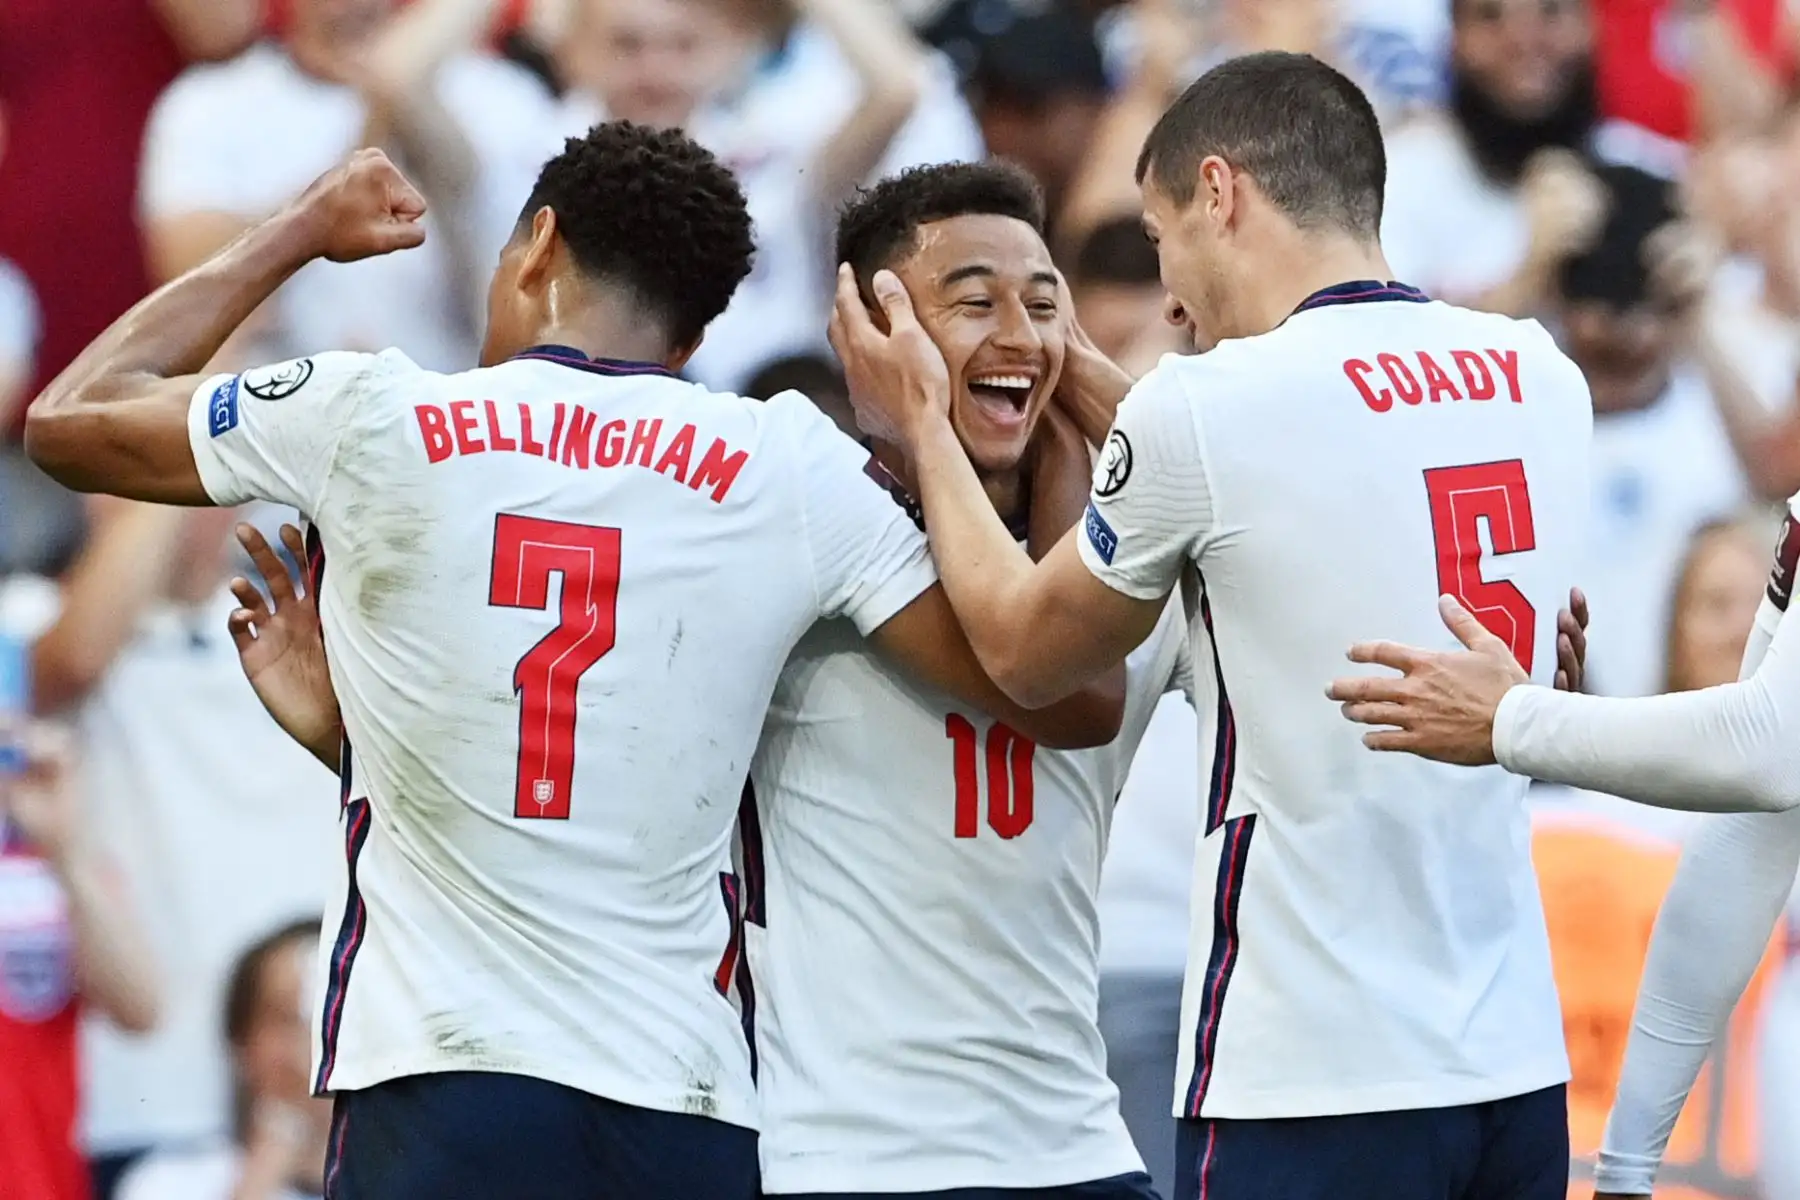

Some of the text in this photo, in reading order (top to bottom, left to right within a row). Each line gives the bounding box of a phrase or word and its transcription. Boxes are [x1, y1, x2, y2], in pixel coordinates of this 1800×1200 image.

[1343, 349, 1523, 413] COADY
[414, 400, 749, 503] BELLINGHAM
[1422, 458, 1536, 678] 5
[488, 512, 622, 820] 7
[945, 712, 1036, 839] 10
